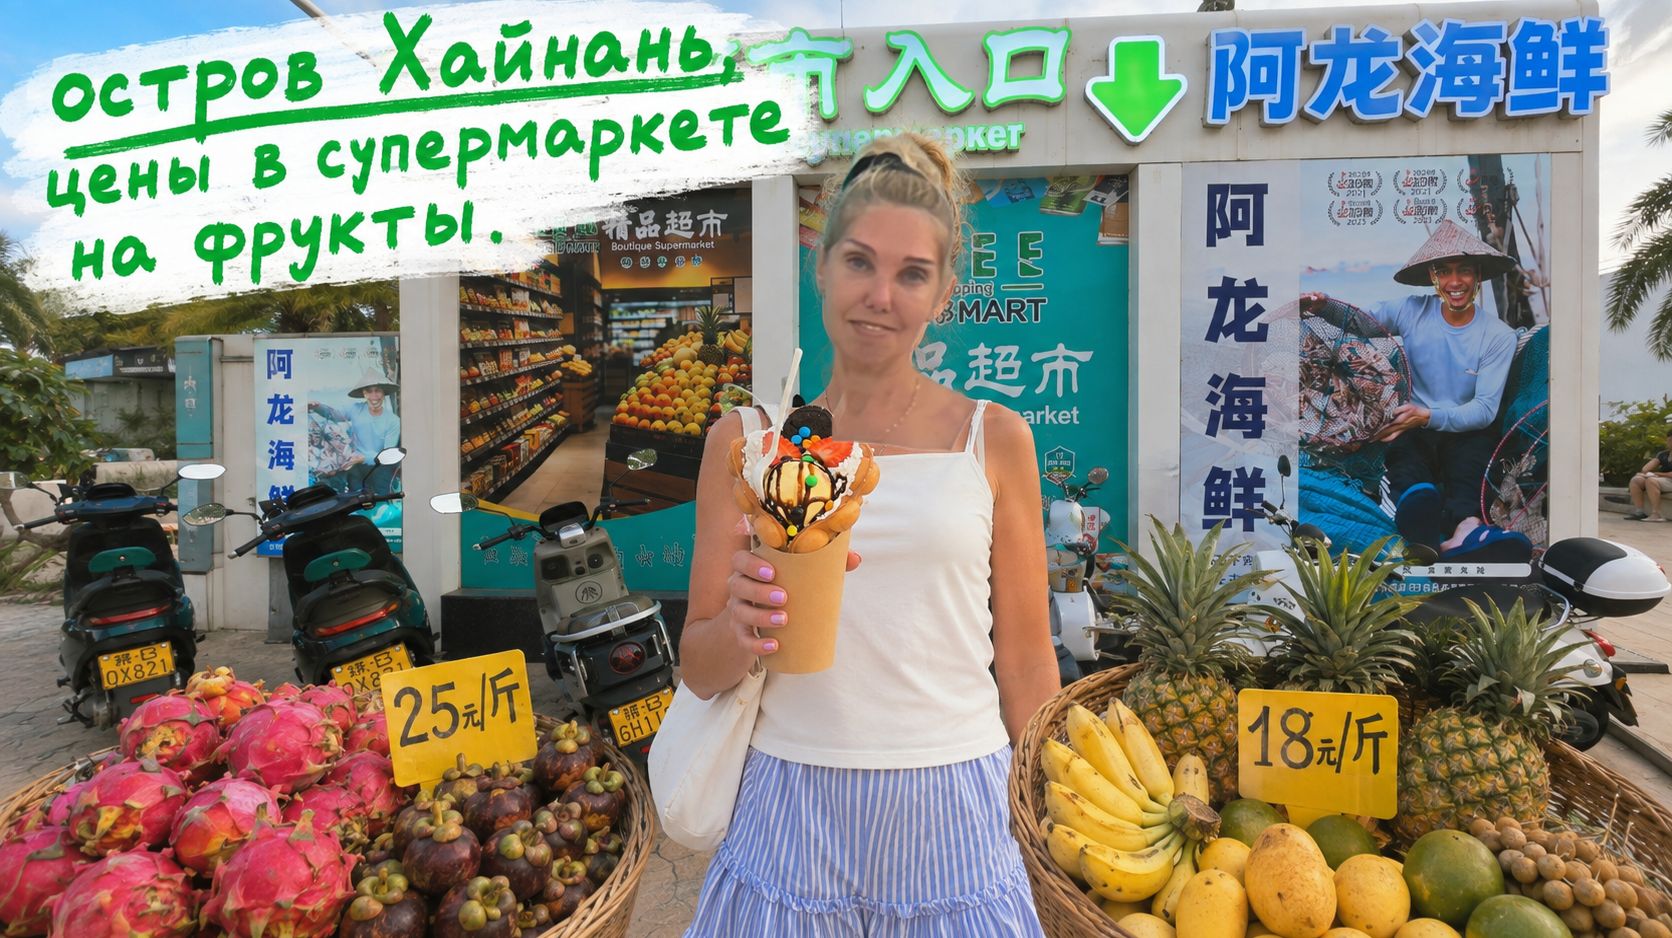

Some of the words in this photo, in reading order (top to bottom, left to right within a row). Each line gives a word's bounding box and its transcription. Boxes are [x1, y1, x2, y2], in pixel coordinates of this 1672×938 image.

[1206, 18, 1610, 126] 阿龙海鲜
[611, 241, 652, 252] Boutique
[655, 240, 715, 251] Supermarket
[1202, 183, 1268, 532] 阿龙海鲜
[393, 667, 520, 748] 25元/斤
[1247, 705, 1389, 775] 18元/斤
